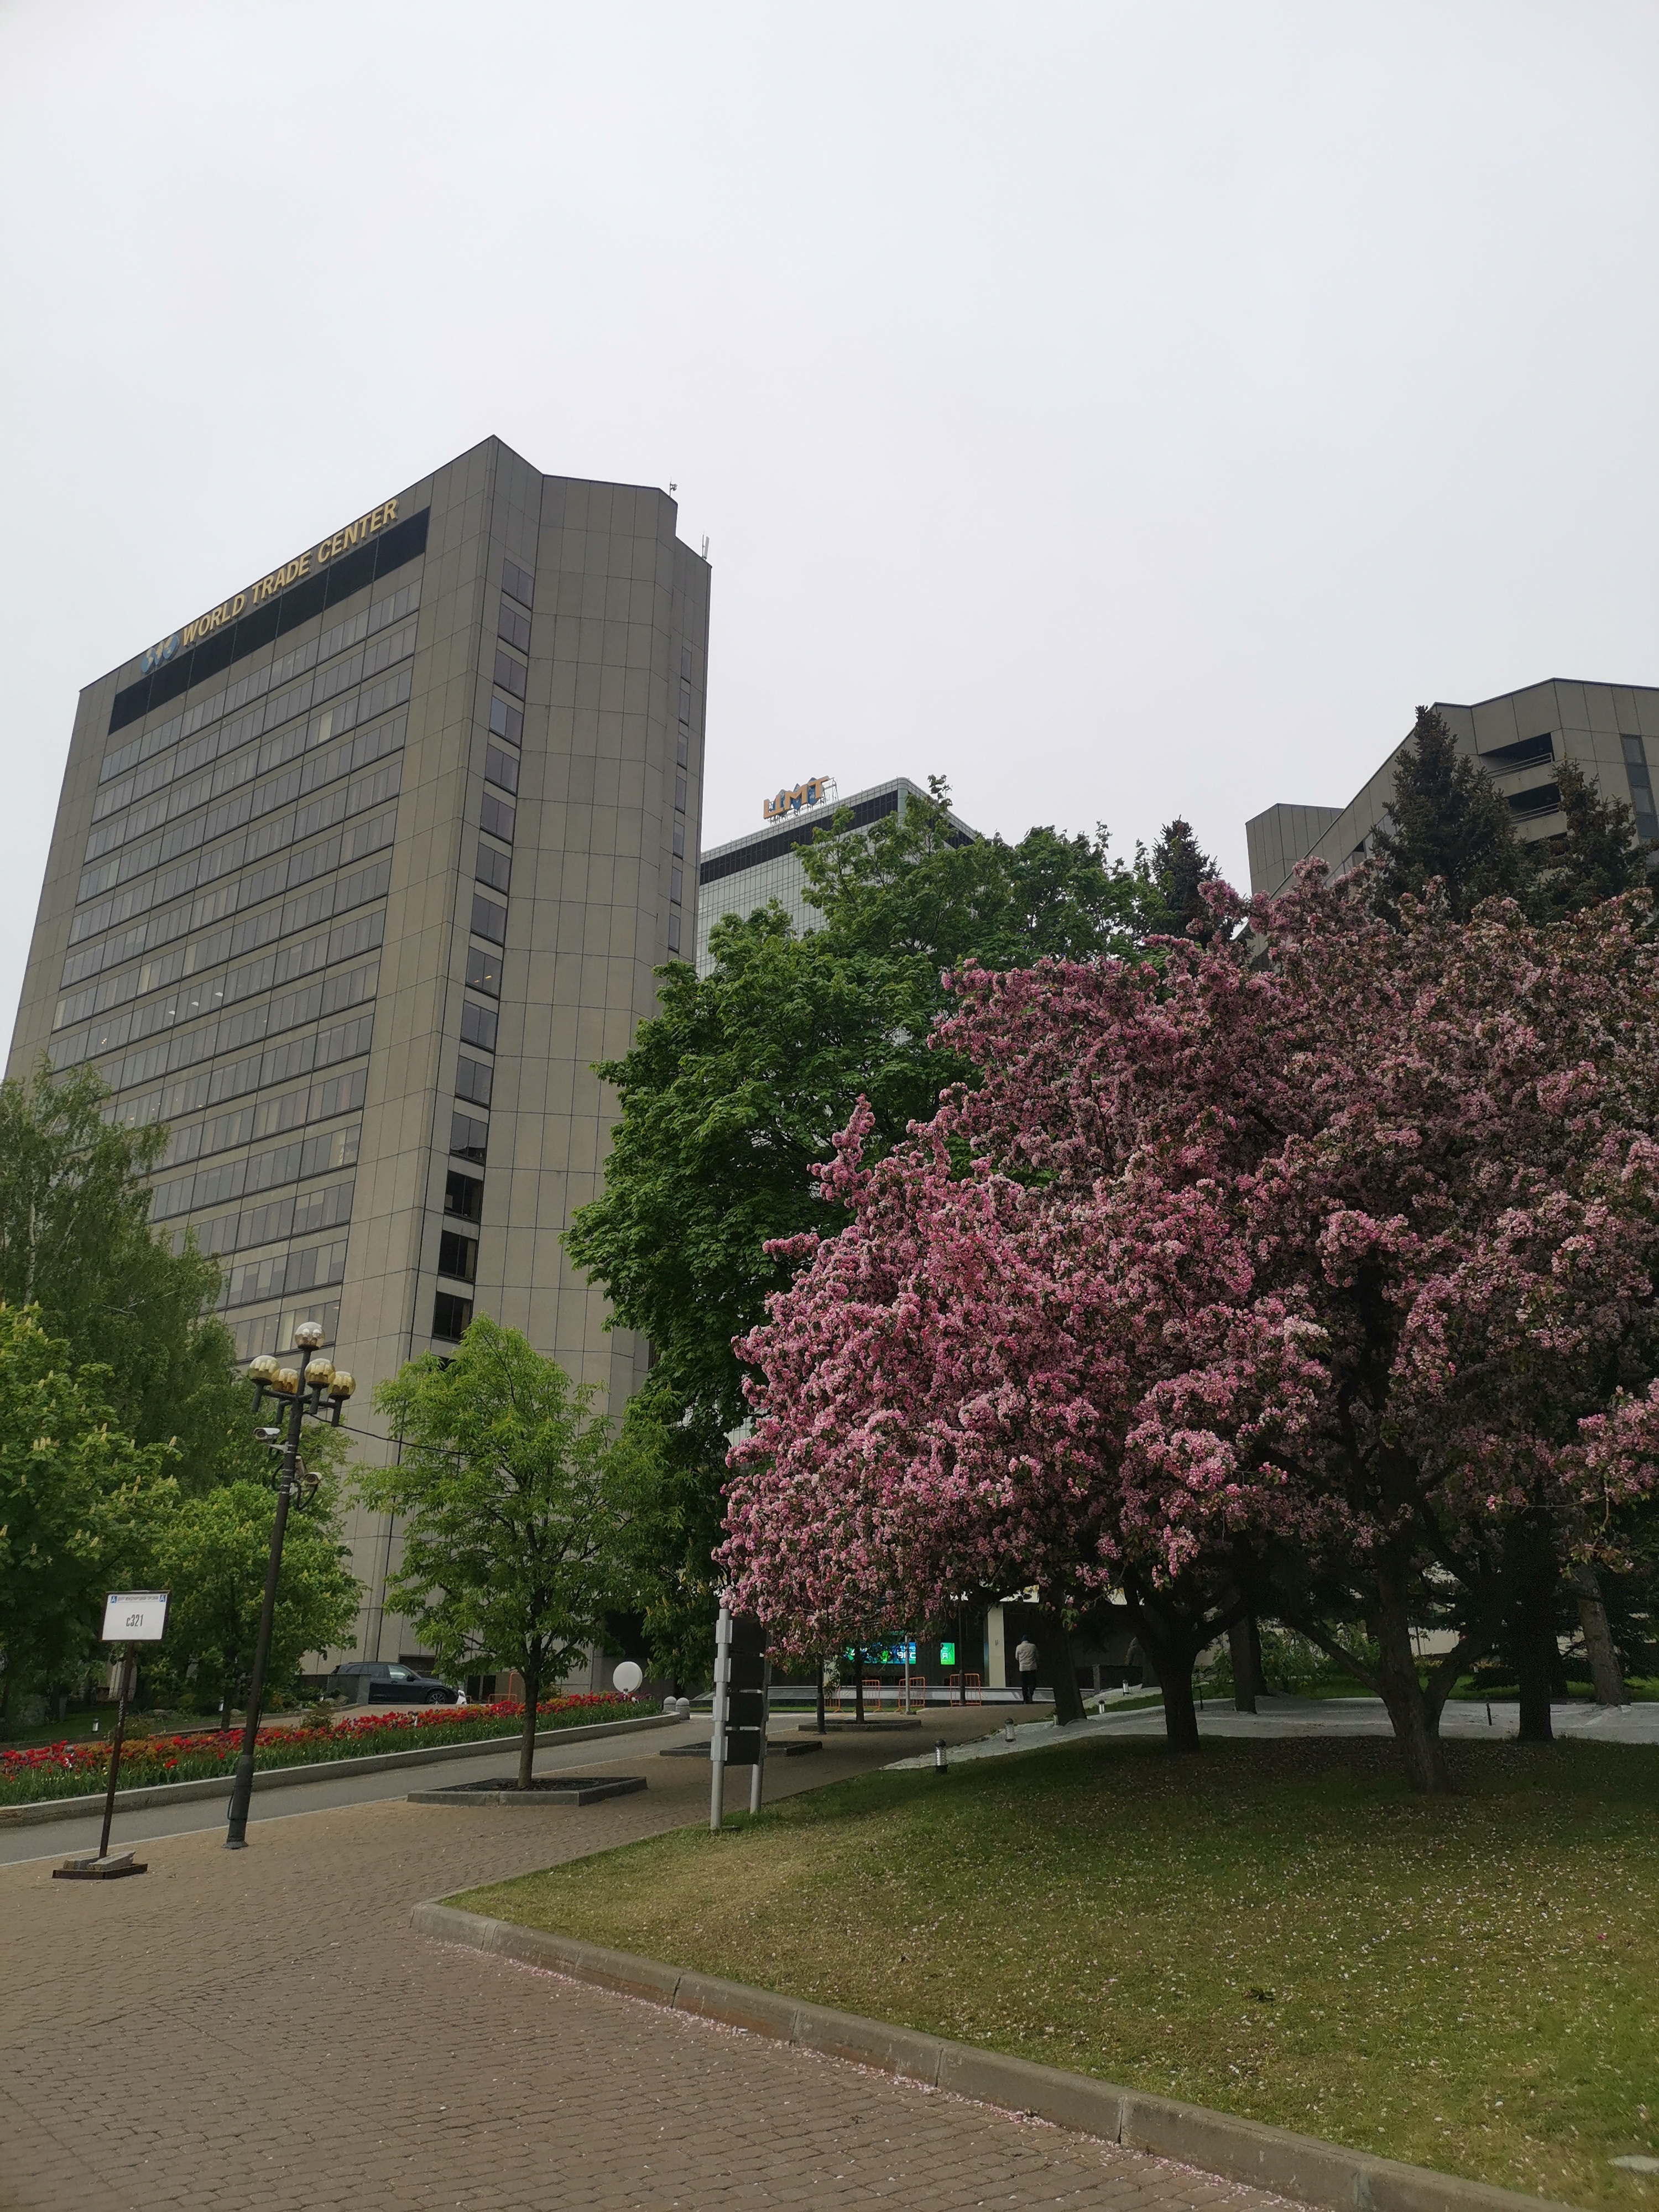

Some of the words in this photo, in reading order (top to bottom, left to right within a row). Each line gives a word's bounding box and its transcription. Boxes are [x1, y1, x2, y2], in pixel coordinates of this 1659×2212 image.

[183, 593, 247, 646] WORLD
[252, 551, 312, 606] TRADE
[317, 498, 398, 564] CENTER
